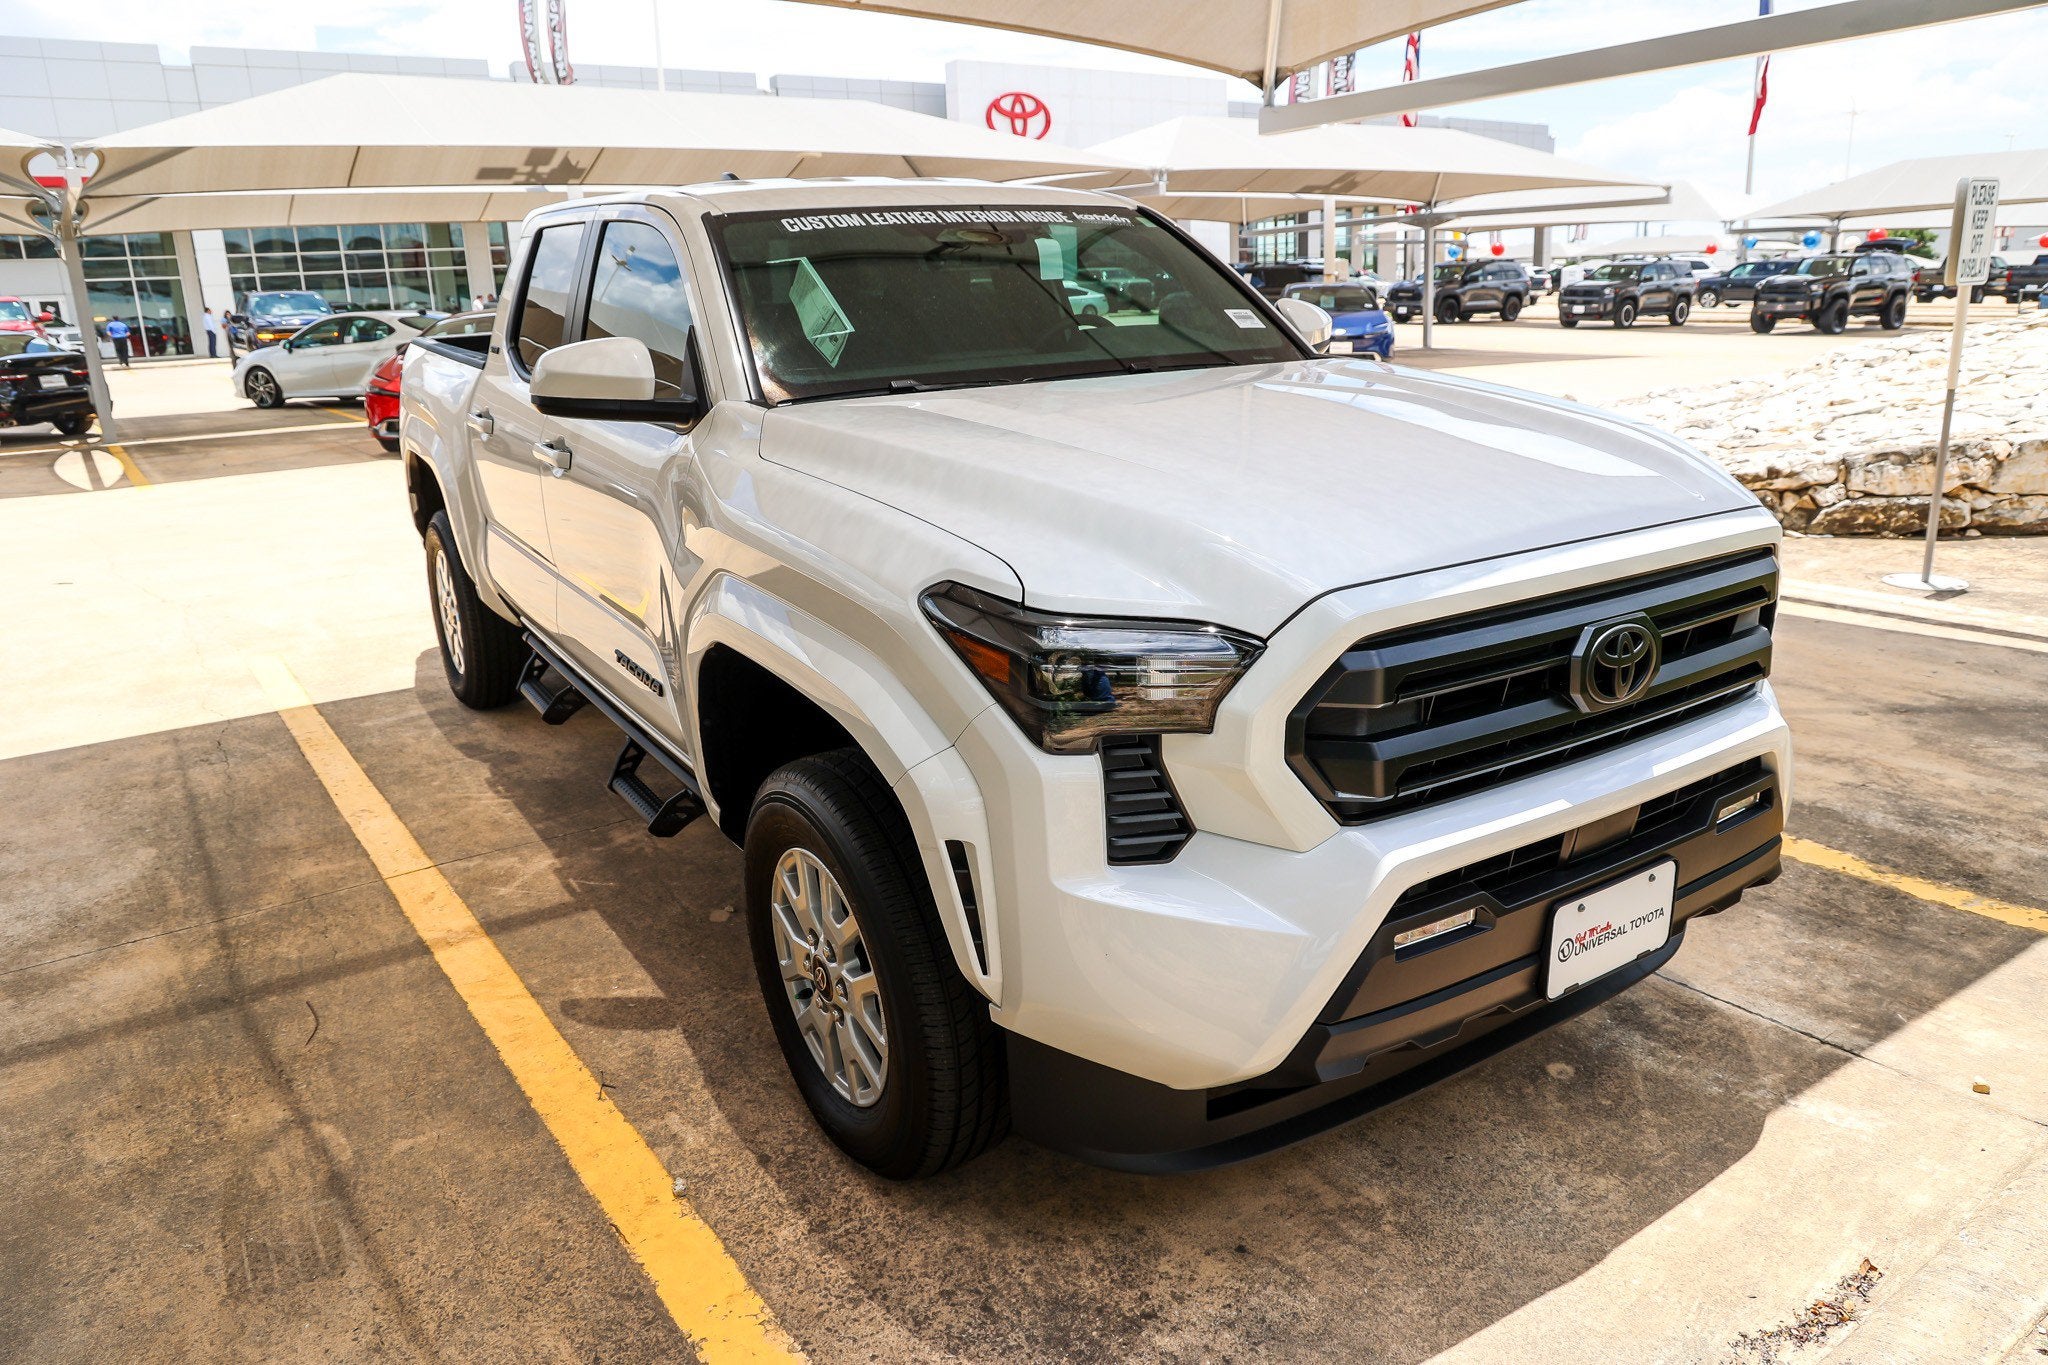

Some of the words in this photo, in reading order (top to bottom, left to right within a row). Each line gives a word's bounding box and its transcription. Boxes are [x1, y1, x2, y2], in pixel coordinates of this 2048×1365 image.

[552, 31, 567, 78] New
[1972, 185, 1996, 205] PLEASE
[781, 213, 866, 232] CUSTOM
[862, 211, 942, 226] LEATHER
[937, 210, 1020, 225] INTERIOR
[1014, 211, 1073, 223] INSIDE
[1972, 209, 1989, 229] KEEP
[1971, 234, 1984, 253] OFF
[1960, 257, 1987, 278] DISPLAY
[614, 649, 664, 697] TACOMA
[1574, 924, 1628, 956] UNIVERSAL
[1629, 907, 1665, 930] TOYOTA
